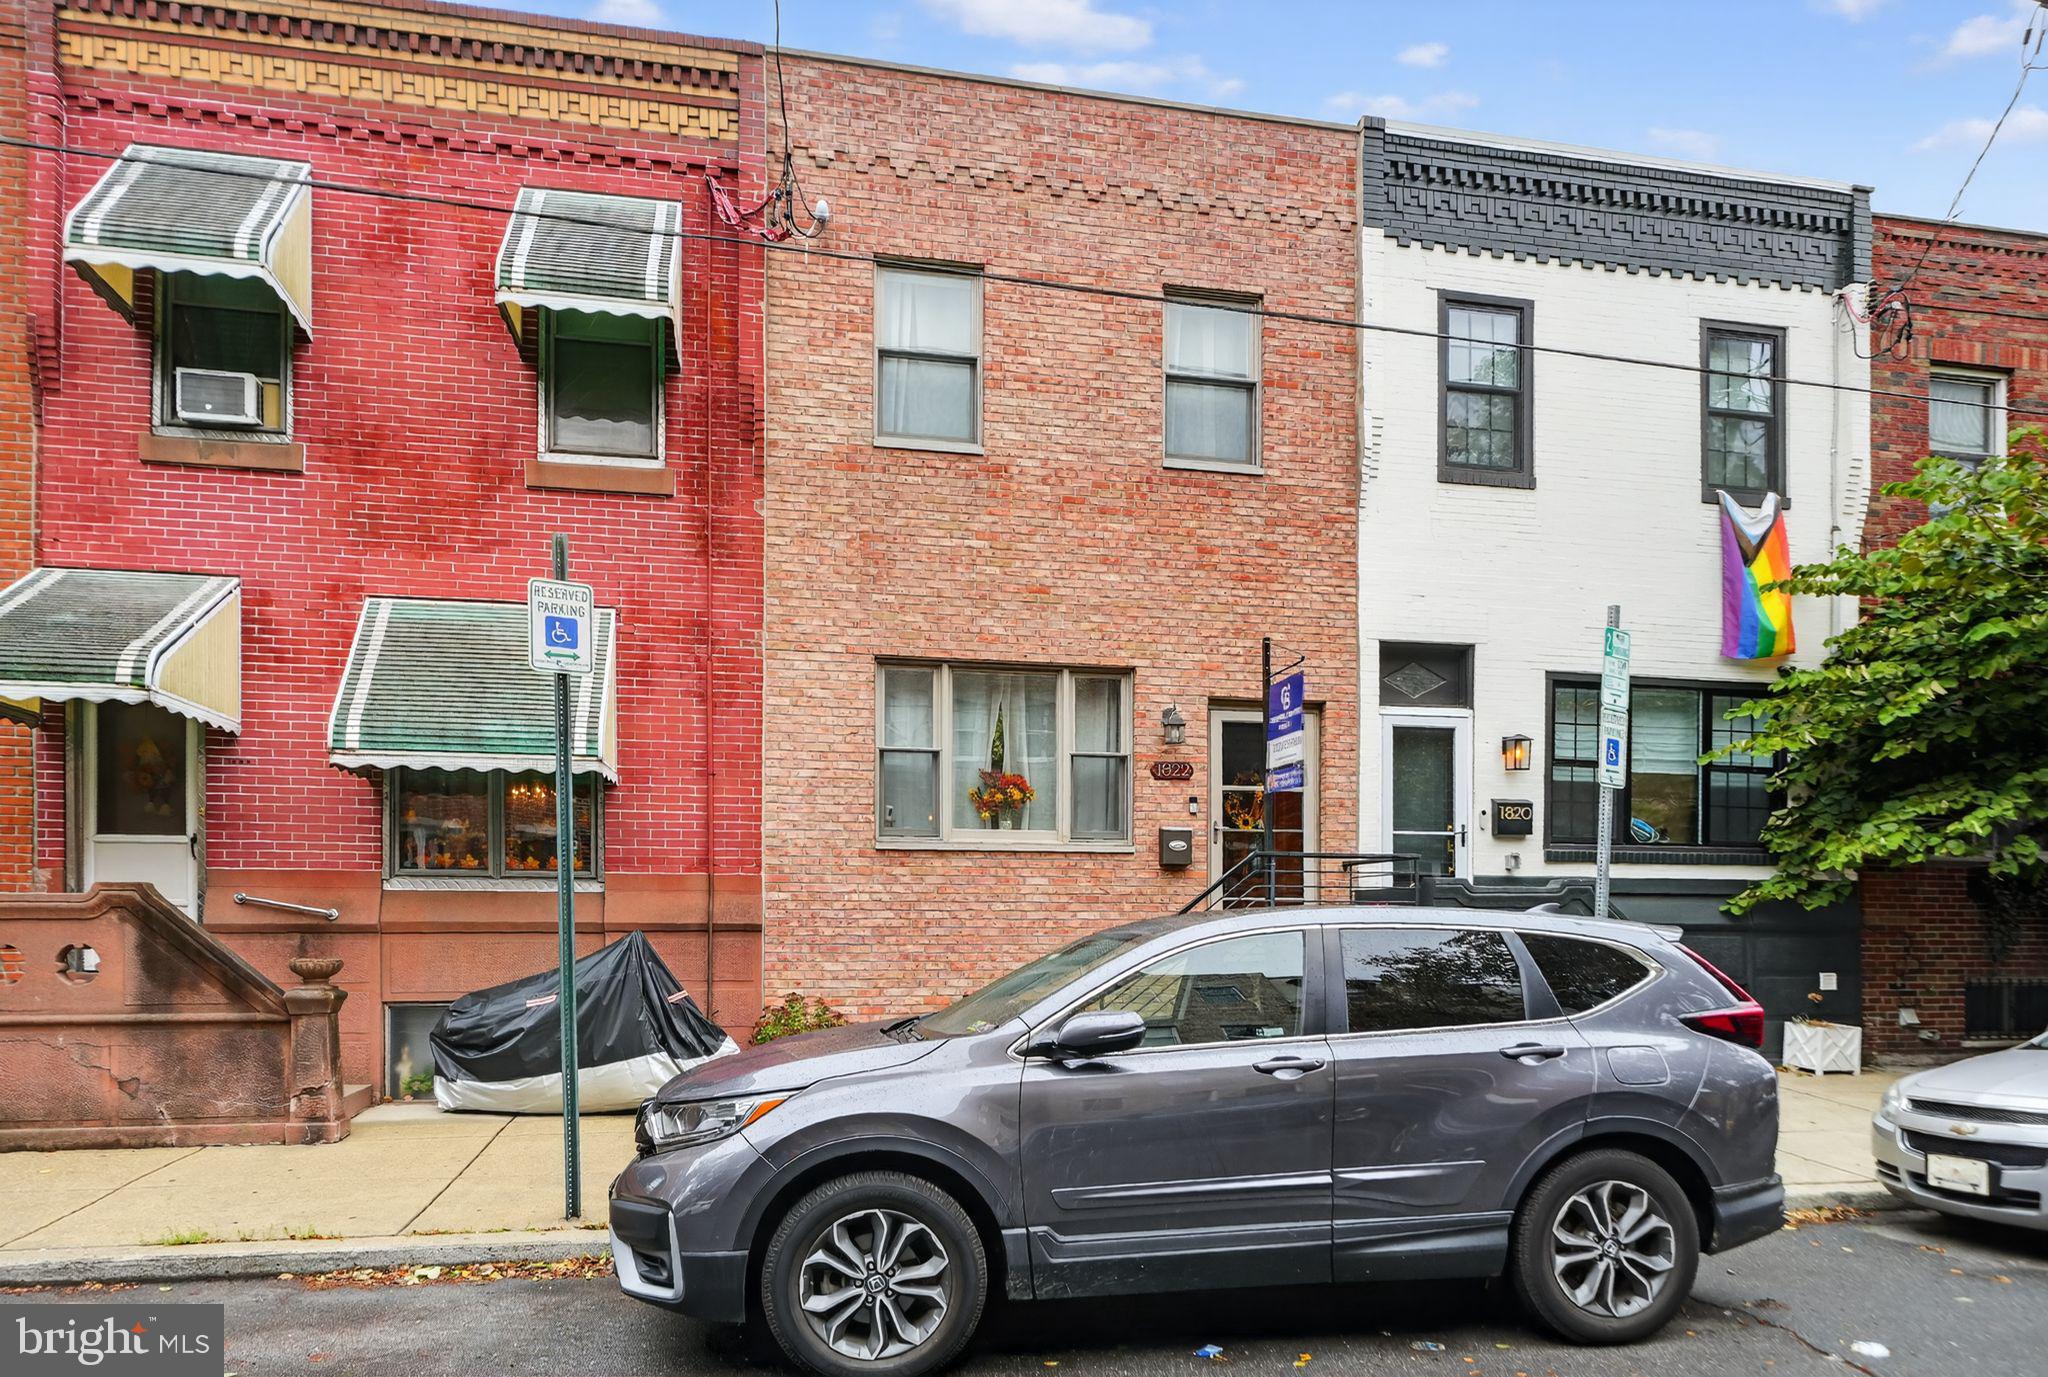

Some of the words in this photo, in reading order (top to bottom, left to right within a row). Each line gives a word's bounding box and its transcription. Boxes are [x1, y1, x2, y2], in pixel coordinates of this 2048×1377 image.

[534, 585, 588, 603] RESERVED
[537, 601, 586, 618] PARKING
[1606, 632, 1612, 652] 2
[1157, 762, 1191, 777] 1822
[1498, 805, 1532, 820] 1820
